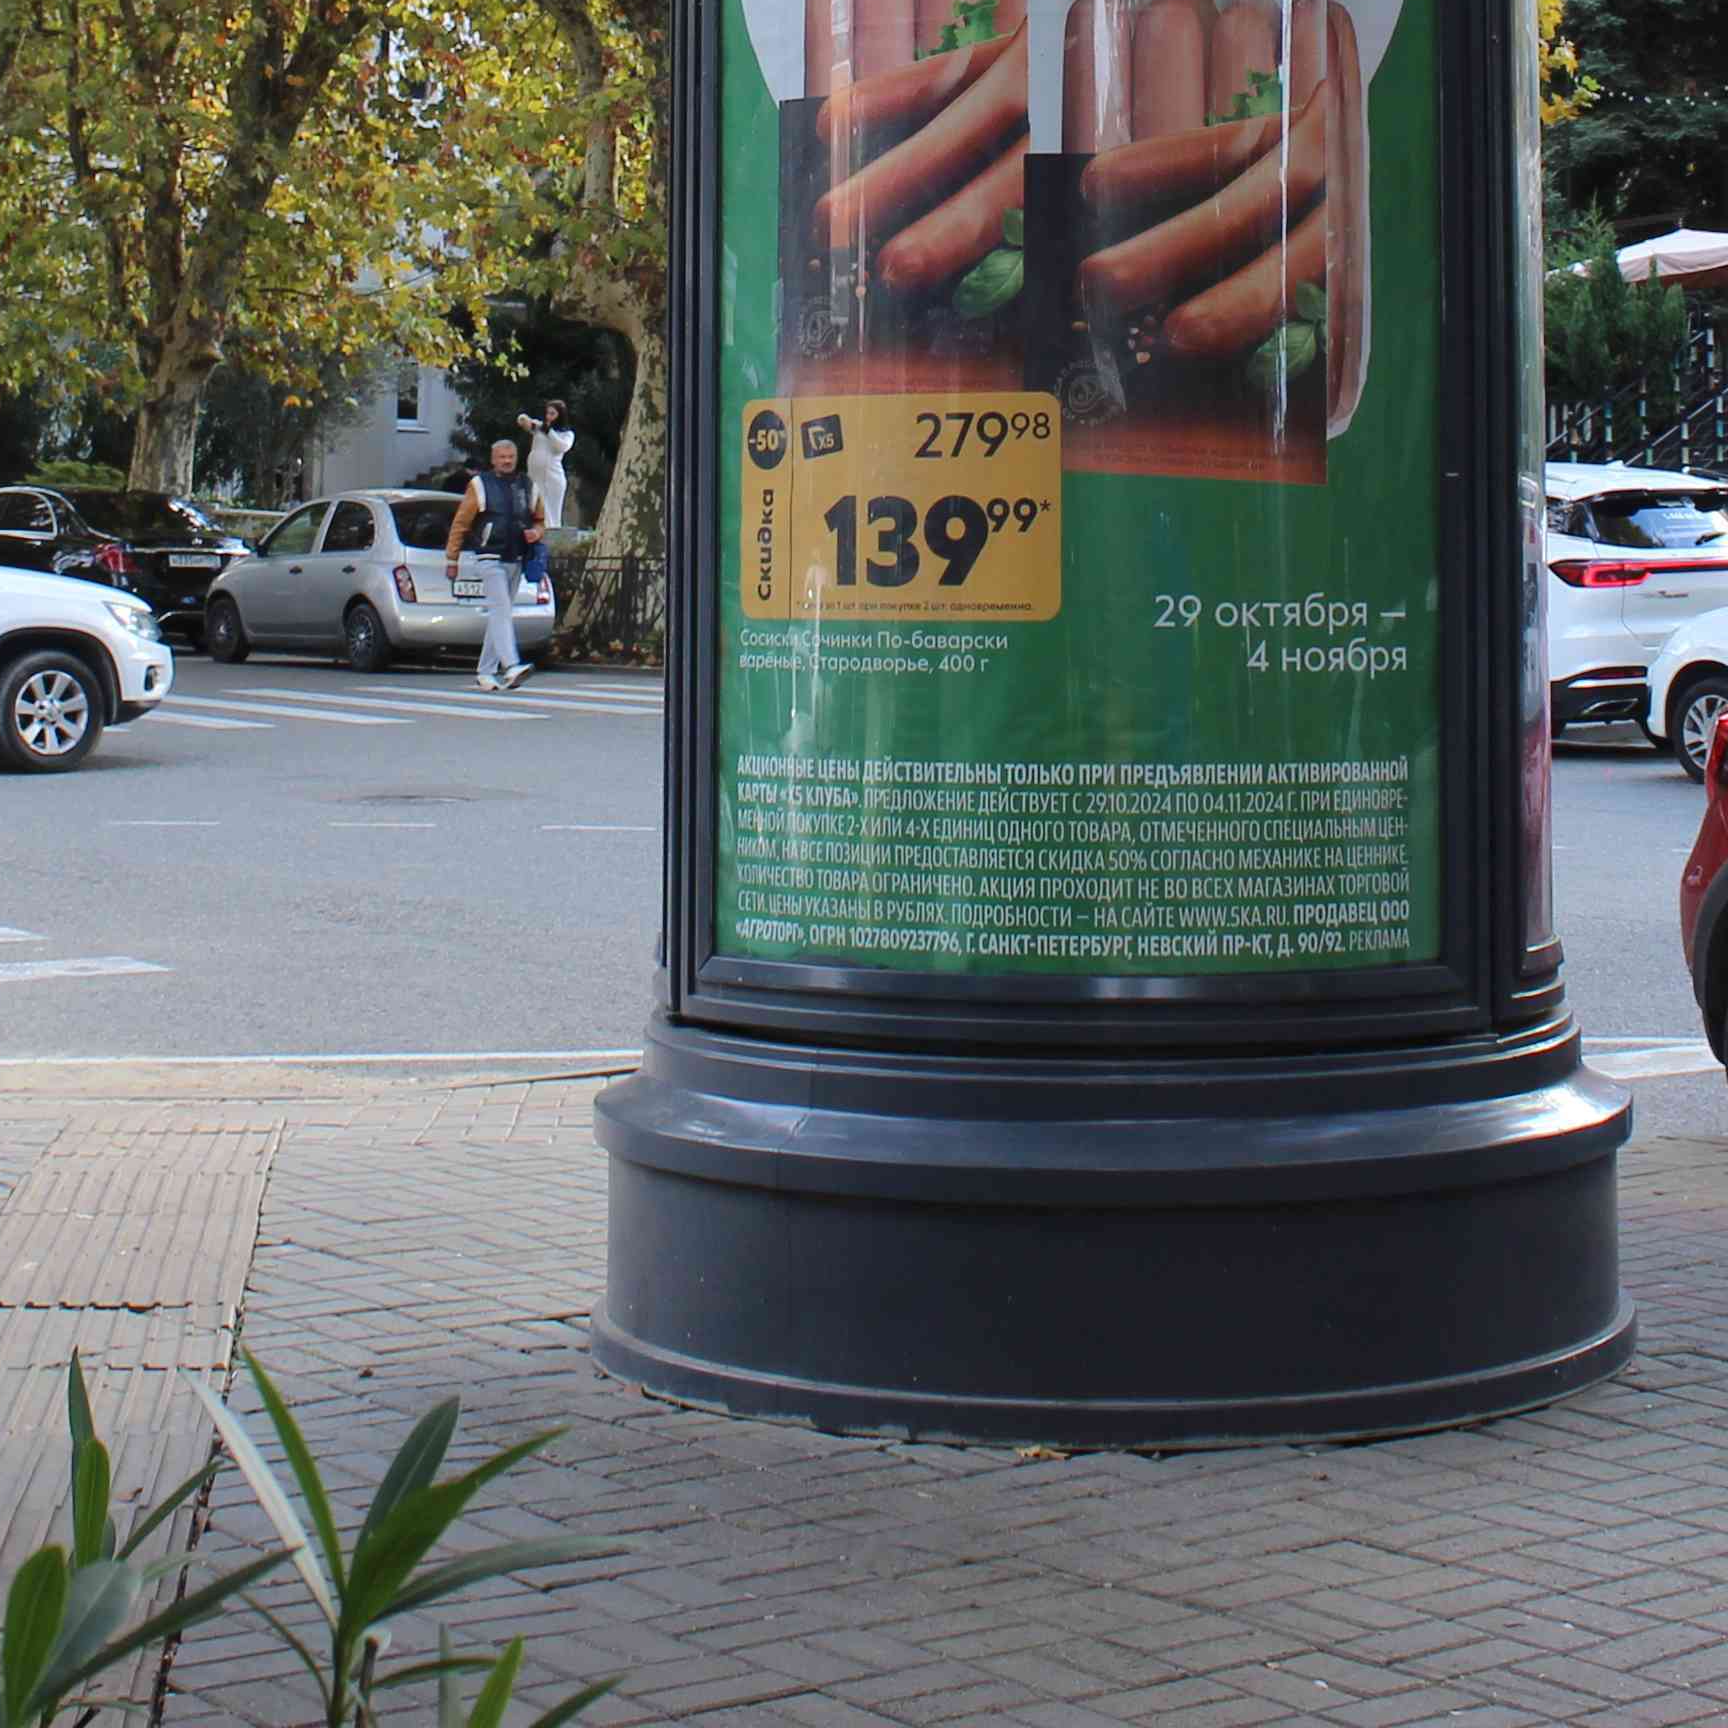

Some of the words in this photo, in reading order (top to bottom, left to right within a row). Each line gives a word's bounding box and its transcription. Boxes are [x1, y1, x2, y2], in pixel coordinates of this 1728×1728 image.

[758, 489, 774, 601] Скидка
[1154, 595, 1202, 628] 29
[1215, 592, 1368, 635] октября
[877, 631, 1008, 652] По-баварски
[1246, 640, 1269, 671] 4
[1282, 637, 1407, 680] ноября
[938, 655, 975, 672] 400
[980, 658, 989, 671] г
[737, 755, 814, 780] АКЦИОННЫЕ
[819, 758, 860, 783] ЦЕНЫ
[863, 755, 1001, 785] ДЕЙСТВИТЕЛЬНЫ
[1005, 764, 1074, 785] ТОЛЬКО
[1079, 764, 1114, 785] ПРИ
[1121, 764, 1263, 788] ПРЕДЪЯВЛЕНИИ
[1267, 755, 1408, 784] АКТИВИРОВАННОЙ
[737, 782, 776, 803] КАРТЫ
[864, 788, 975, 813] ПРЕДЛОЖЕНИЕ
[978, 787, 1069, 815] ДЕЙСТВУЕТ
[1073, 792, 1082, 813] С
[1086, 792, 1171, 814] 29.10.2024
[1175, 792, 1199, 813] ПО
[1203, 792, 1284, 813] 04.11.2024
[1288, 792, 1298, 813] Г.
[1301, 790, 1330, 812] ПРИ
[1334, 787, 1409, 813] ЕДИНОВРЕ-
[789, 812, 845, 835] ПОКУПКЕ
[874, 816, 902, 837] ИЛИ
[933, 818, 994, 844] ЕДИНИЦ
[998, 821, 1064, 845] ОДНОГО
[1069, 821, 1136, 845] ТОВАРА,
[1139, 820, 1260, 842] ОТМЕЧЕННОГО
[1264, 816, 1375, 843] СПЕЦИАЛЬНЫМ
[1379, 816, 1409, 839] ЦЕН-
[782, 838, 799, 859] НА
[801, 840, 822, 861] ВСЕ
[826, 841, 890, 867] ПОЗИЦИИ
[895, 845, 1034, 871] ПРЕДОСТАВЛЯЕТСЯ
[1038, 849, 1105, 873] СКИДКА
[1109, 849, 1147, 871] 50%
[1150, 848, 1235, 871] СОГЛАСНО
[1239, 847, 1321, 870] МЕХАНИКЕ
[1324, 846, 1343, 866] НА
[736, 863, 814, 889] КОЛИЧЕСТВО
[817, 870, 869, 892] ТОВАРА
[873, 872, 976, 897] ОГРАНИЧЕНО.
[980, 876, 1035, 901] АКЦИЯ
[1040, 877, 1134, 902] ПРОХОДИТ
[1138, 878, 1159, 899] НЕ
[1164, 878, 1187, 899] ВО
[1192, 877, 1234, 899] ВСЕХ
[1238, 875, 1335, 899] МАГАЗИНАХ
[1340, 867, 1409, 896] ТОРГОВОЙ
[769, 894, 802, 916] ЦЕНЫ
[805, 895, 870, 920] УКАЗАНЫ
[874, 900, 883, 920] В
[951, 903, 1072, 929] ПОДРОБНОСТИ
[1094, 907, 1118, 928] НА
[1122, 902, 1174, 928] САЙТЕ
[1293, 901, 1377, 929] ПРОДАВЕЦ
[1380, 899, 1409, 921] ООО
[810, 926, 846, 945] ОГРН
[849, 928, 962, 956] 1027809237796,
[966, 932, 975, 953] Г.
[979, 933, 1132, 959] САНКТ-ПЕТЕРБУРГ,
[1137, 930, 1218, 956] НЕВСКИЙ
[1223, 933, 1272, 959] ПР-КТ,
[1277, 934, 1294, 958] Д.
[1298, 930, 1345, 954] 90/92.
[1349, 928, 1409, 950] РЕКЛАМА
